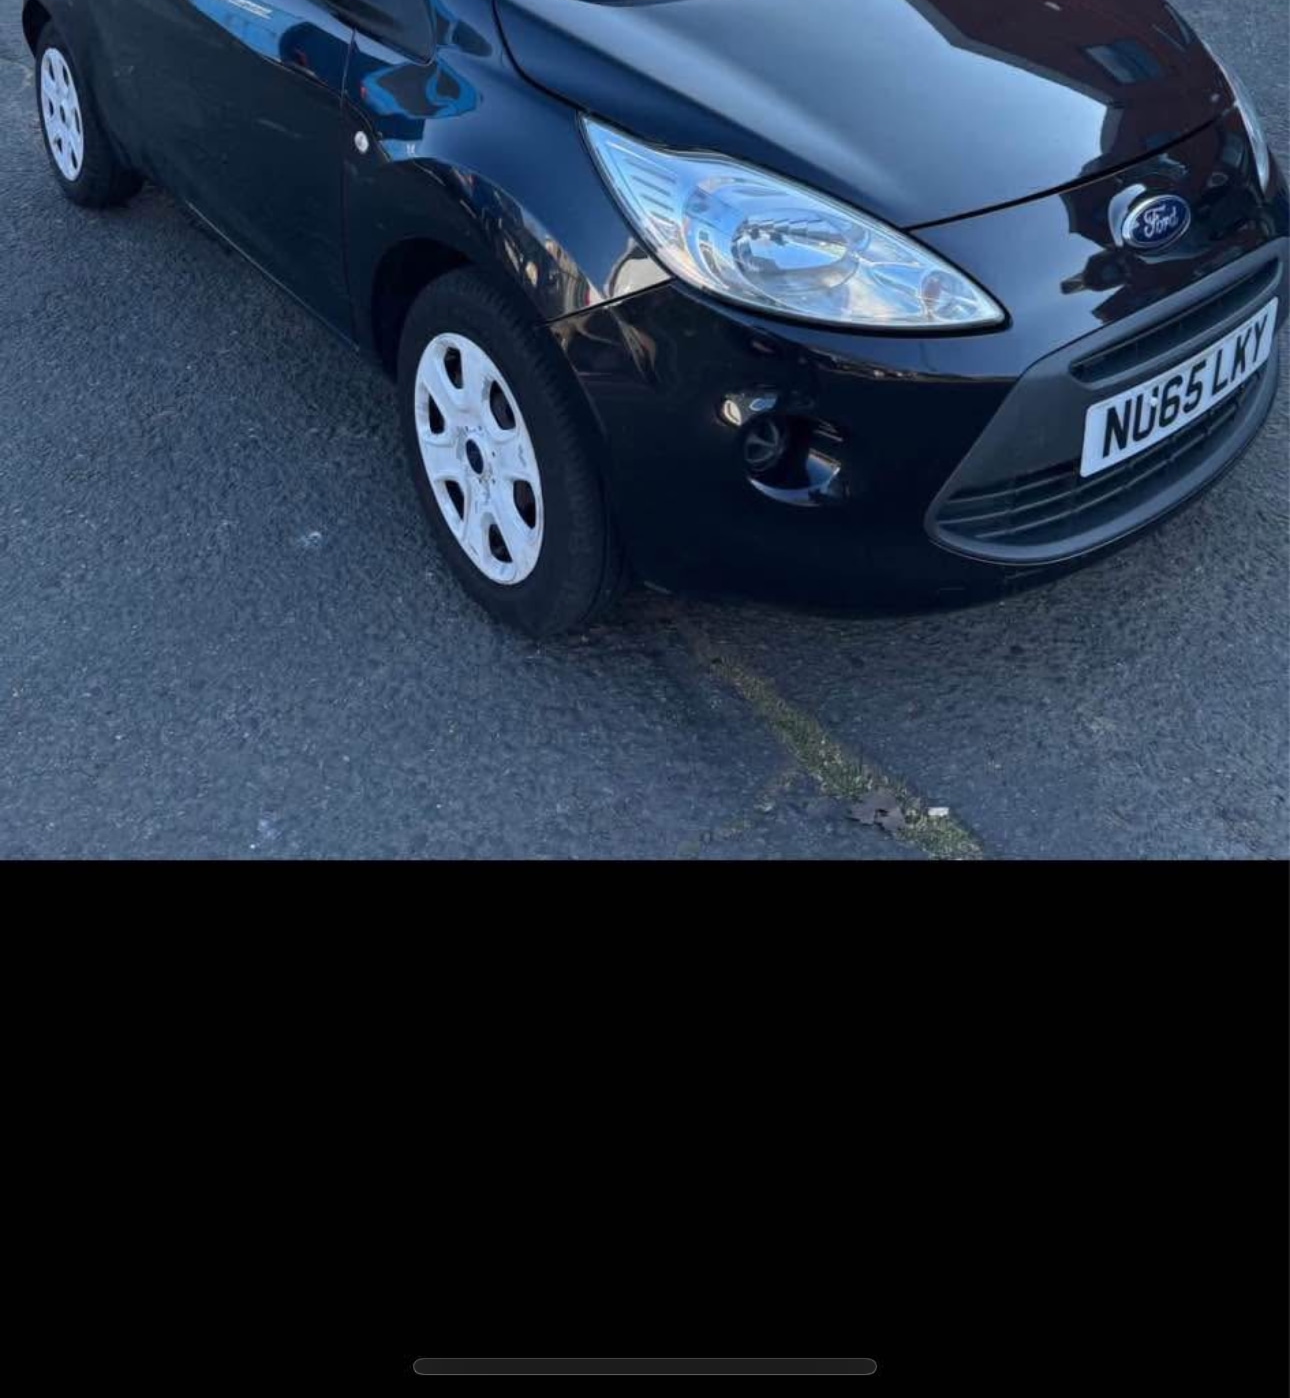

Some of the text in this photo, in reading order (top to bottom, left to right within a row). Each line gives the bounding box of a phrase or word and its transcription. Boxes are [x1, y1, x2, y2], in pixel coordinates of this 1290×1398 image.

[1143, 204, 1179, 239] Ford
[1102, 313, 1269, 460] NU65 LKY
